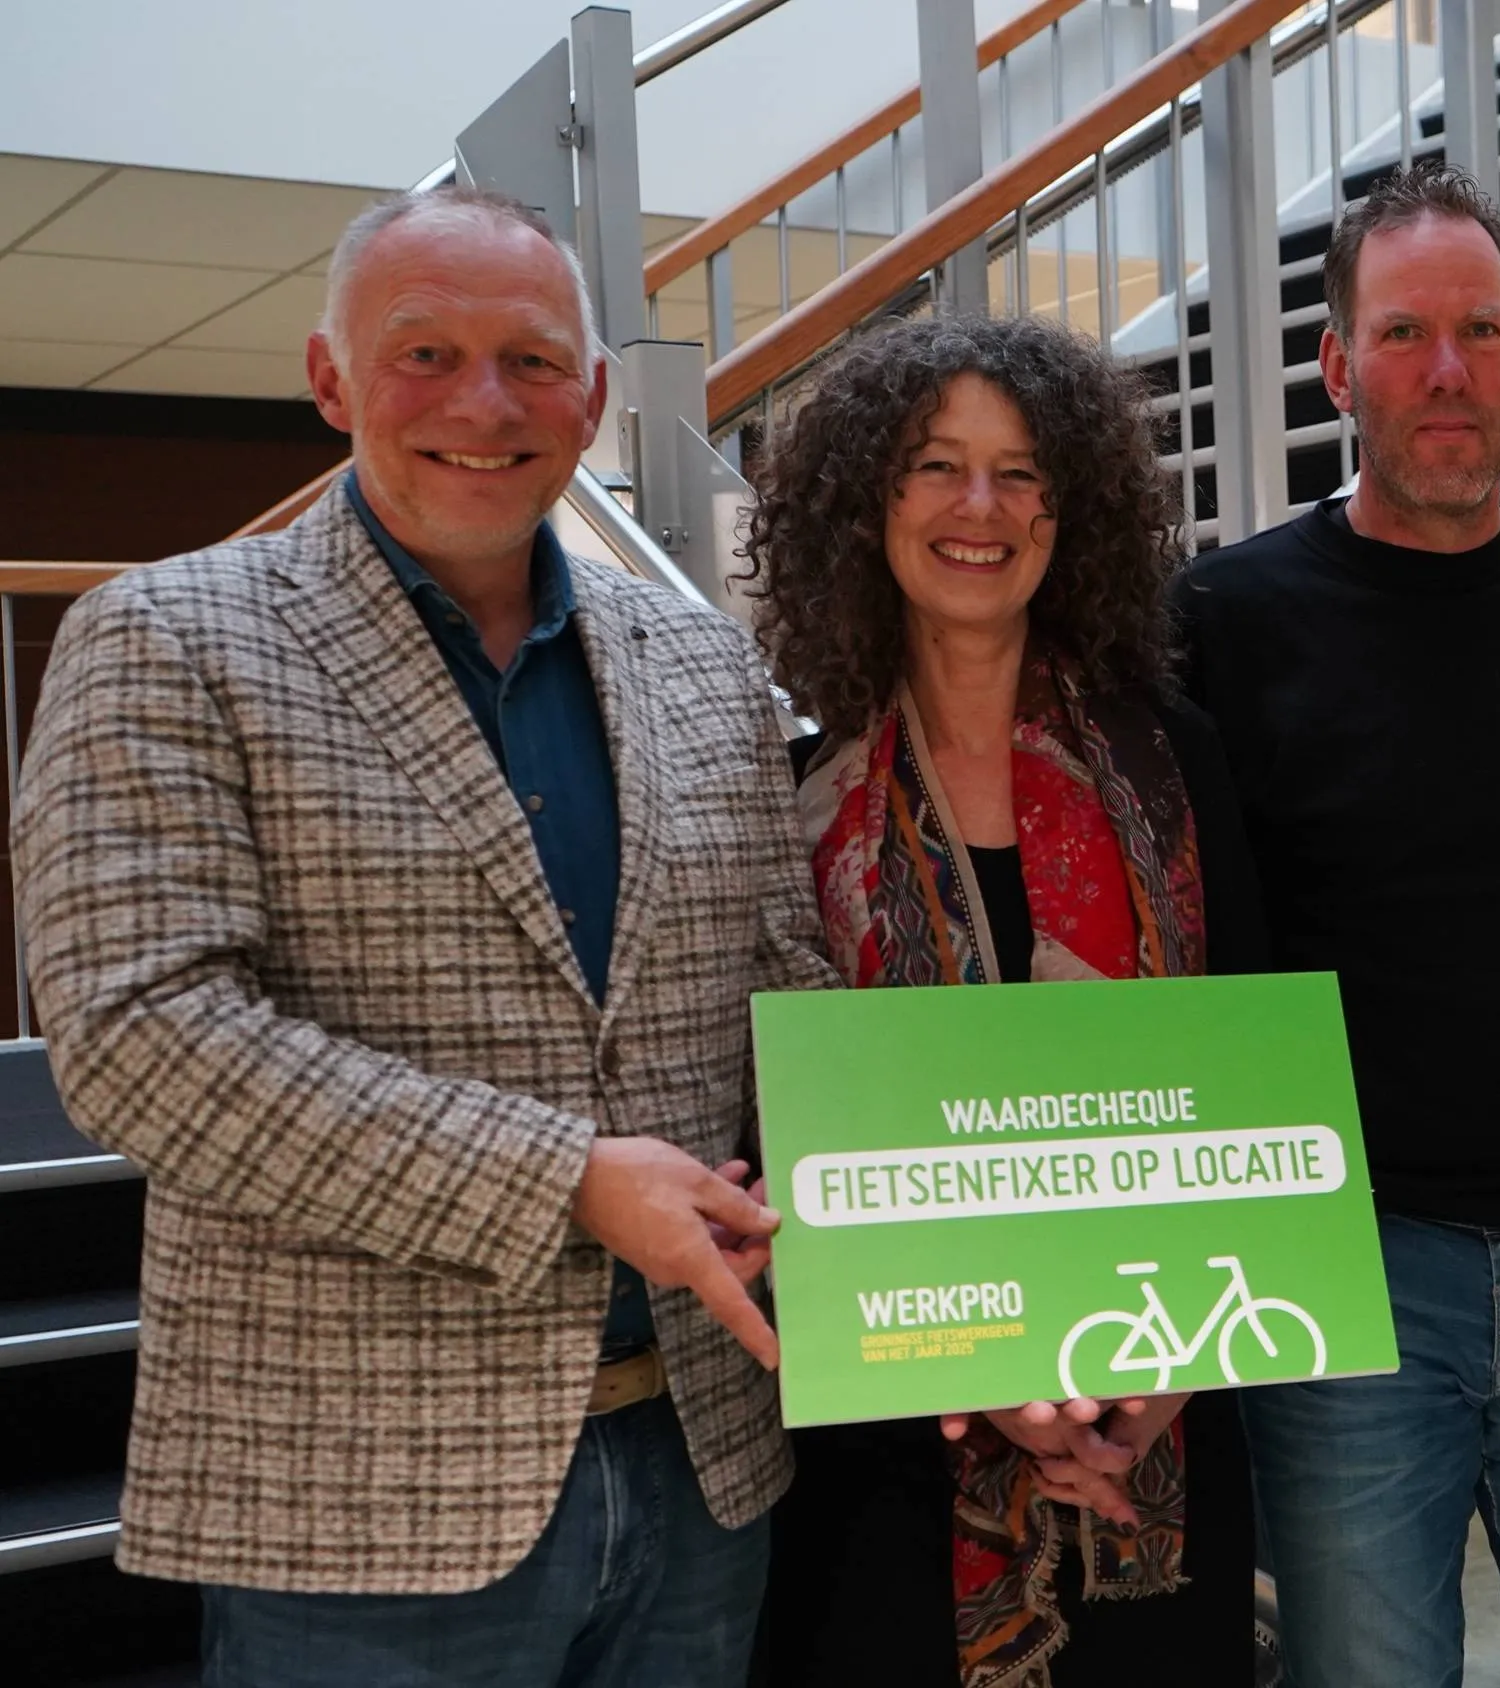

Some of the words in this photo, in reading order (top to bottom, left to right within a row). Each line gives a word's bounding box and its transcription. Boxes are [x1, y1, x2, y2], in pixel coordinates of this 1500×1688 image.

[941, 1087, 1197, 1134] WAARDECHEQUE
[819, 1153, 1097, 1212] FIETSENFIXER
[1111, 1149, 1160, 1192] OP
[1175, 1139, 1323, 1186] LOCATIE
[857, 1281, 1024, 1330] WERKPRO
[860, 1331, 924, 1348] GRONINGSE
[927, 1323, 1025, 1342] FIETSWERKGEVER
[862, 1348, 887, 1363] VAN
[889, 1346, 909, 1360] HET
[914, 1344, 942, 1358] JAAR
[945, 1341, 975, 1356] 2025
